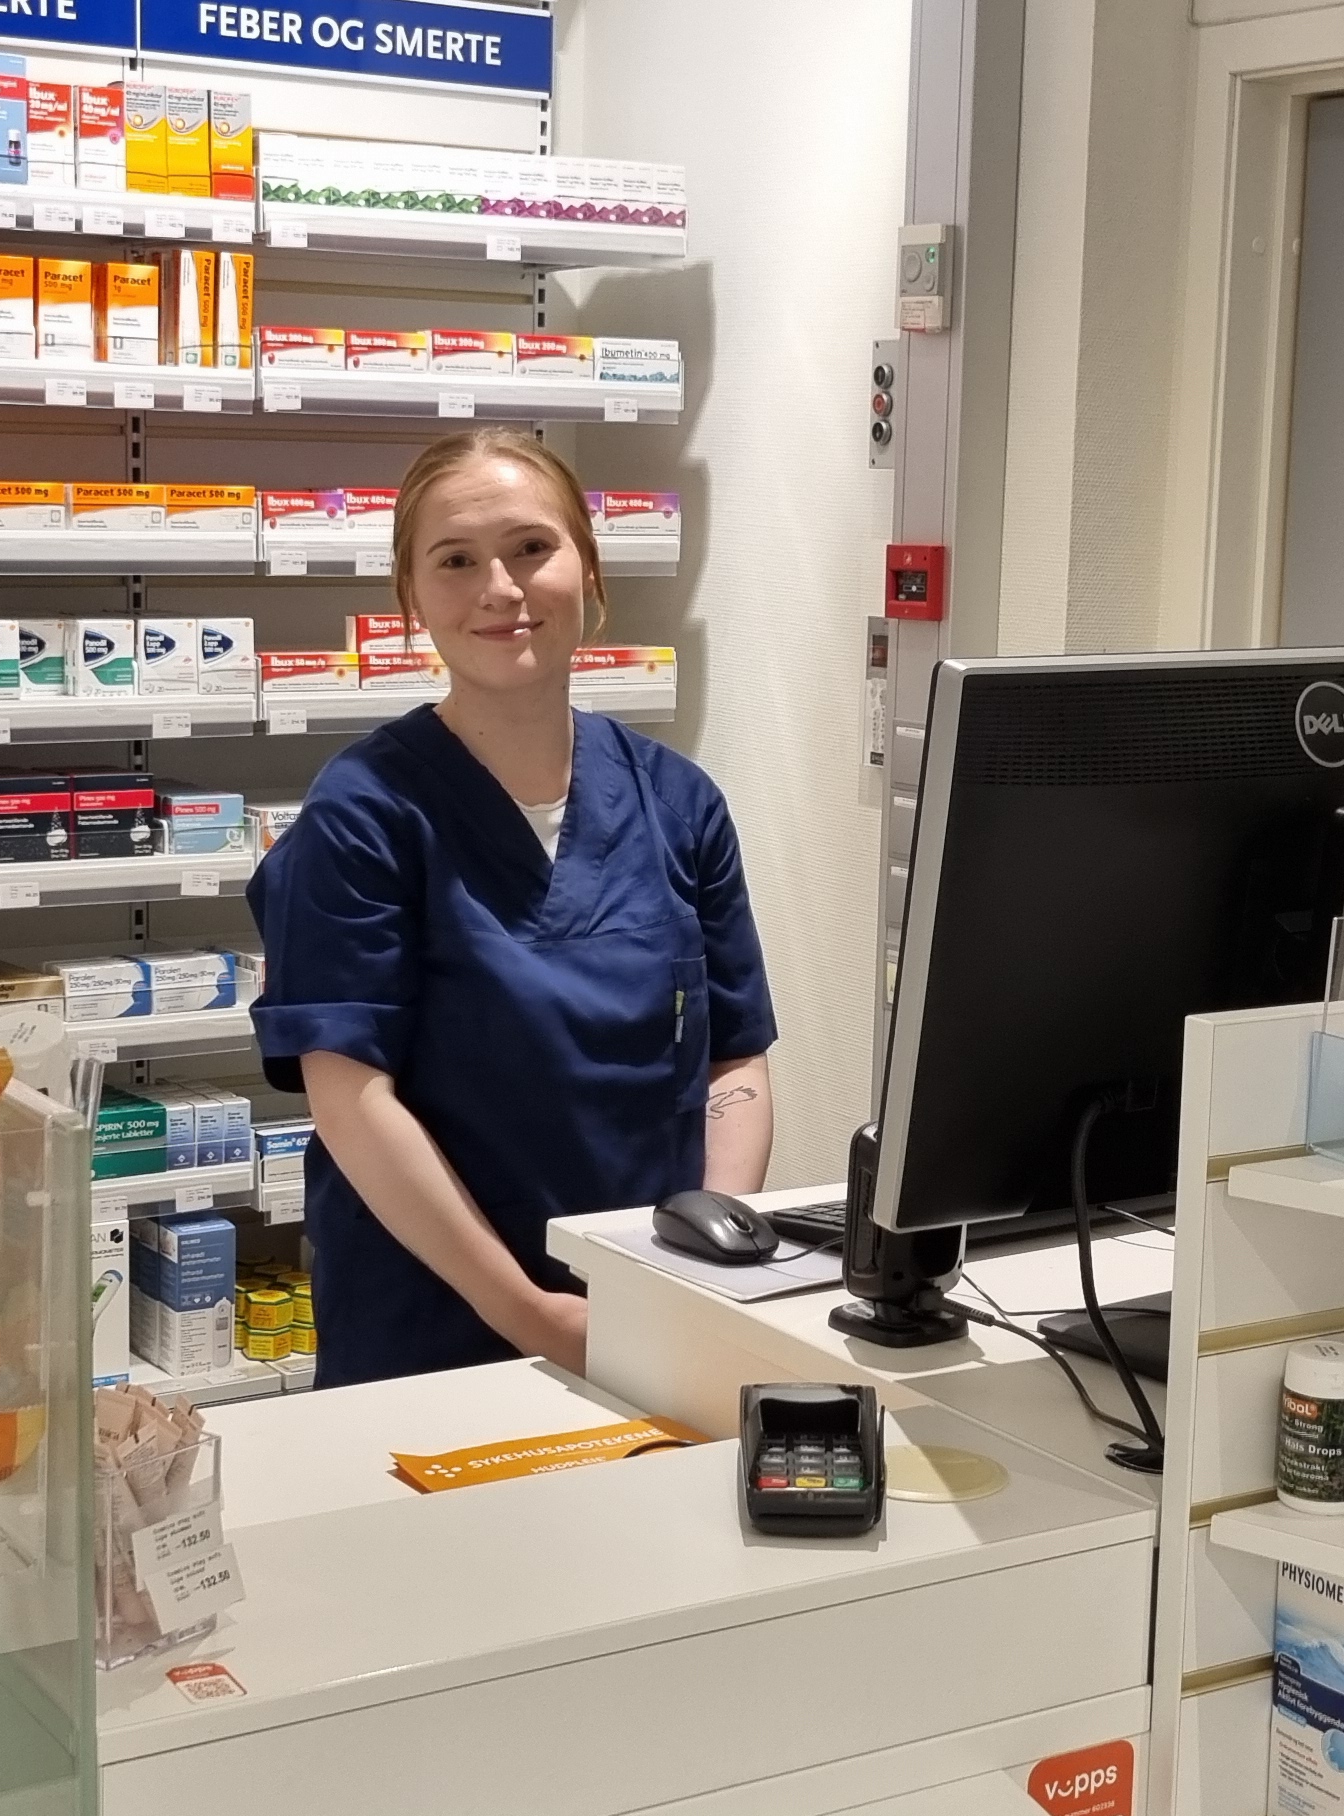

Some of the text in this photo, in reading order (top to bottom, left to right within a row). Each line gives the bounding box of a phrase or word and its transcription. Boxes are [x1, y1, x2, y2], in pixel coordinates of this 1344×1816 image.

[199, 3, 502, 66] FEBER OG SMERTE
[467, 1427, 665, 1469] SYKEHUSAPOTEKENE
[1308, 1444, 1342, 1460] Drops
